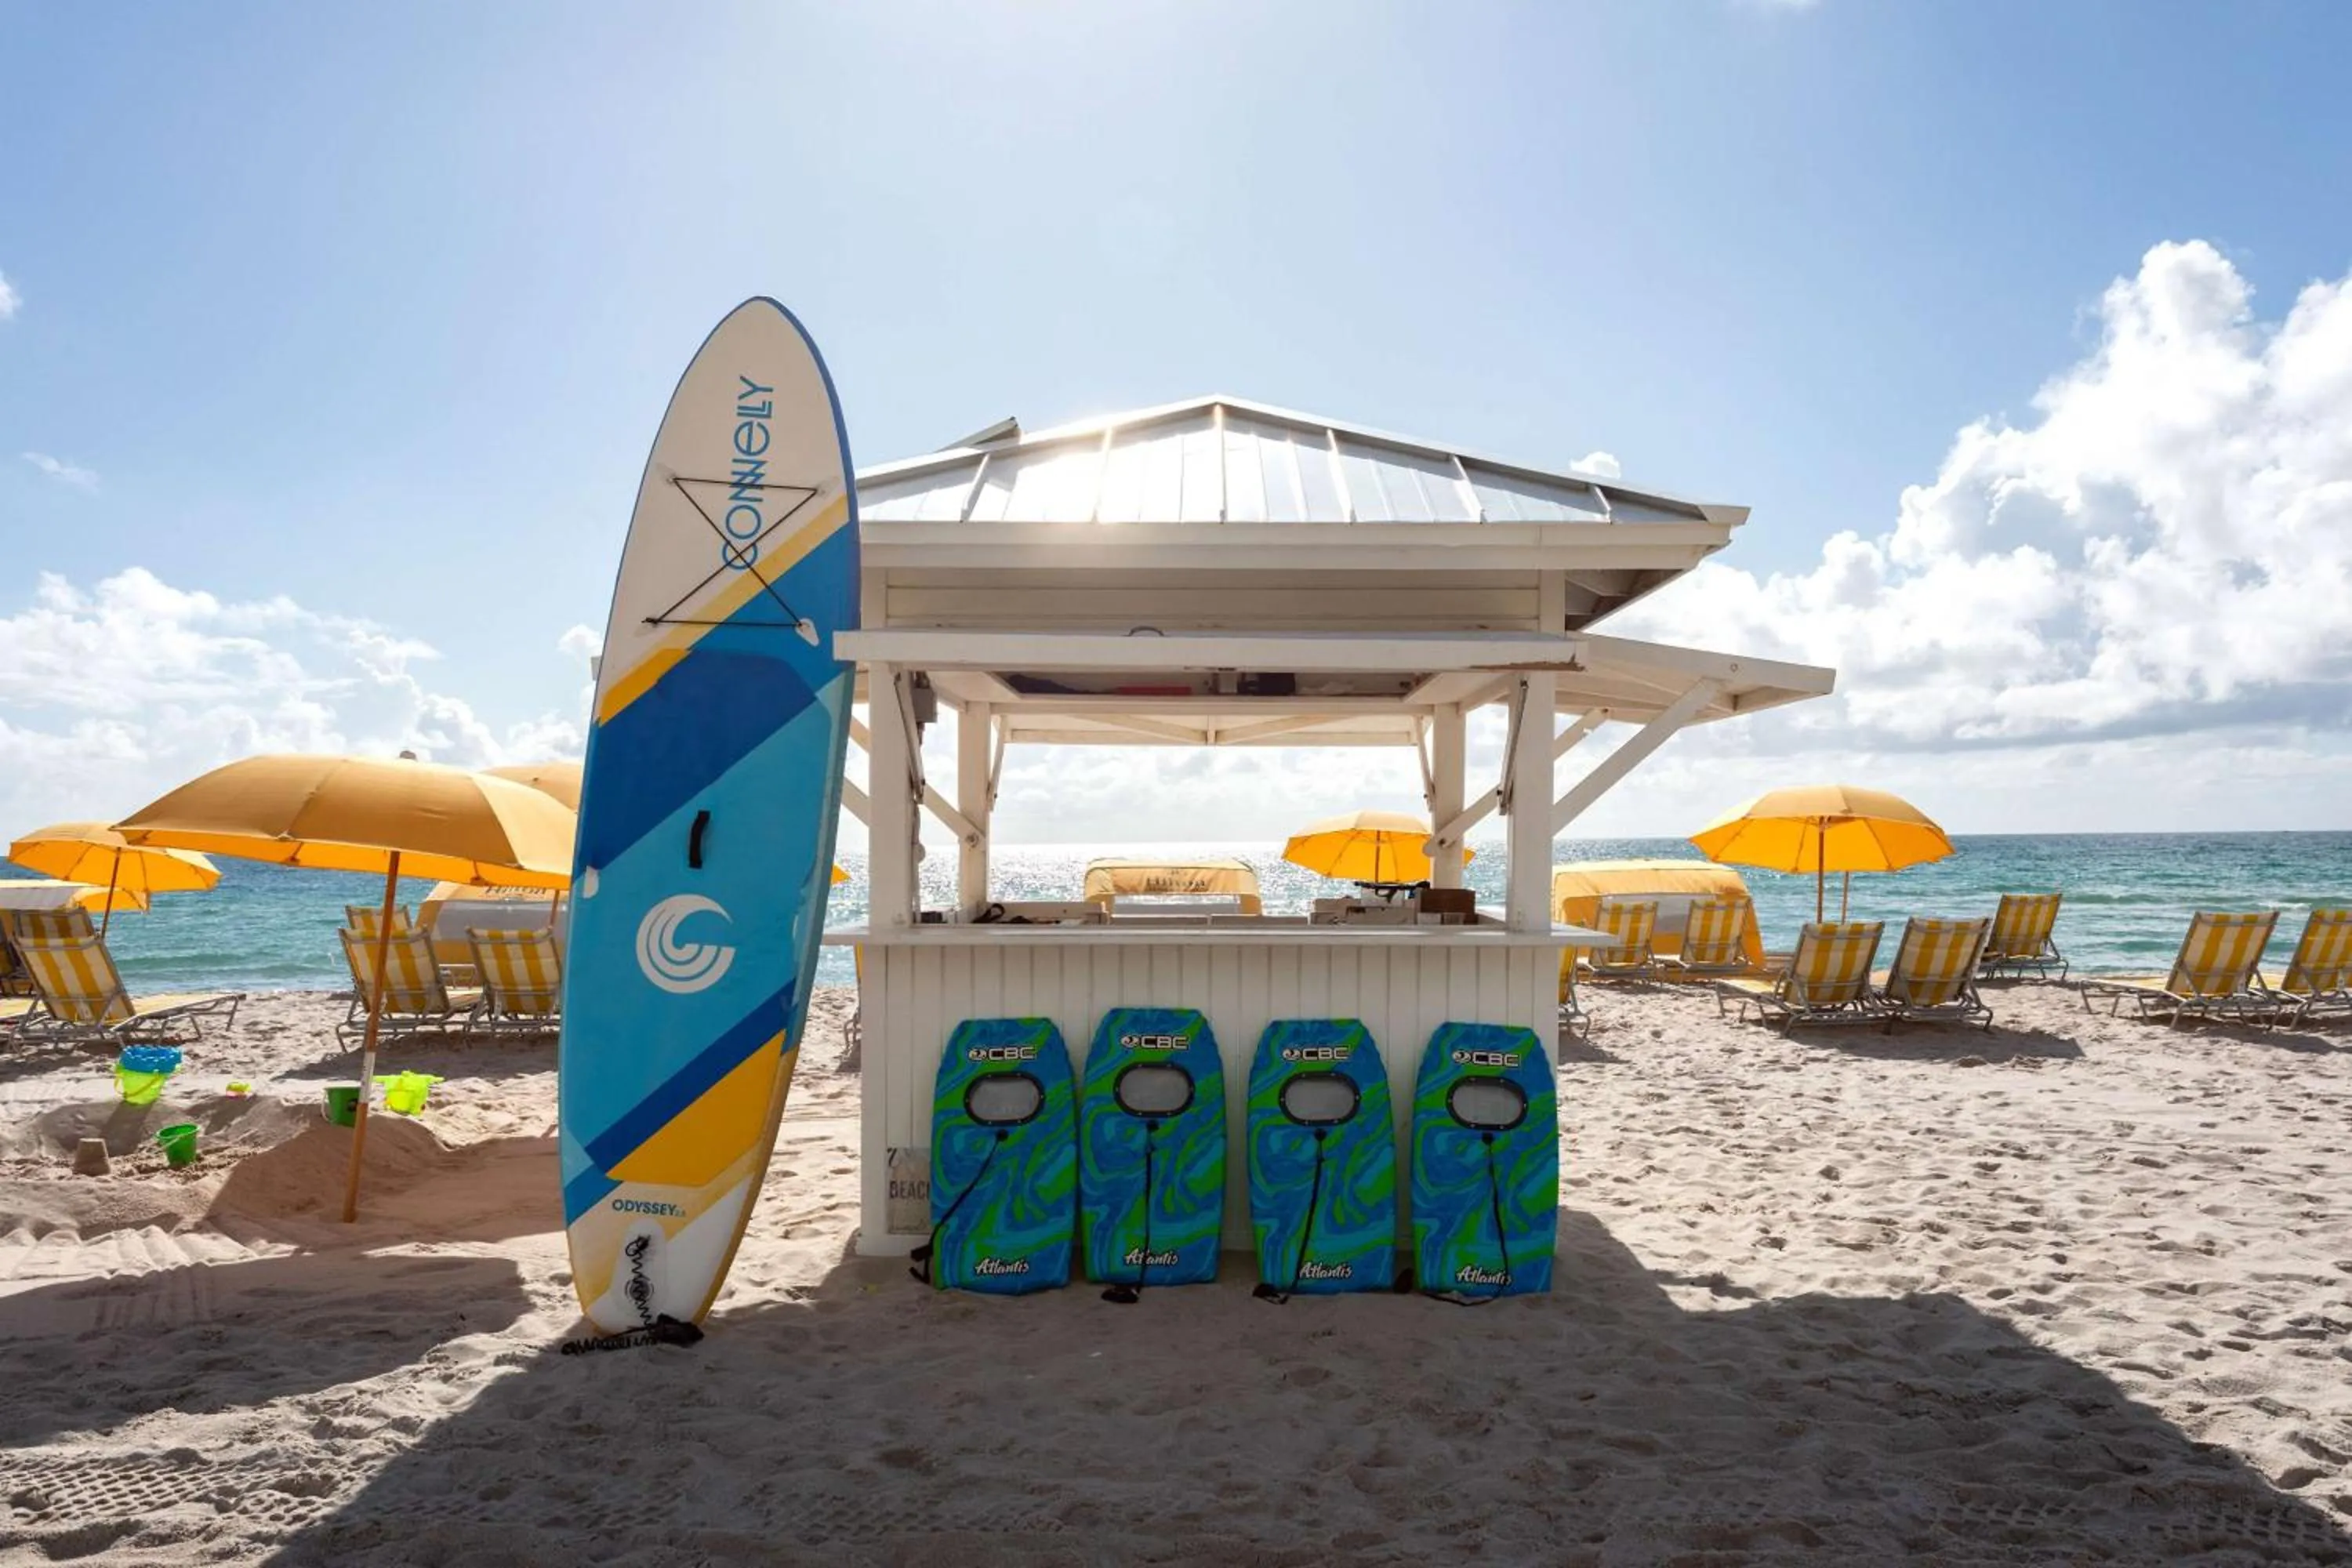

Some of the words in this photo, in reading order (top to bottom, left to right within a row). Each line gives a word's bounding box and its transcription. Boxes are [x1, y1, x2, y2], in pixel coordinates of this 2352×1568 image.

[1140, 1035, 1189, 1050] CBC
[988, 1047, 1036, 1061] CBC
[1302, 1047, 1351, 1061] CBC
[1472, 1051, 1520, 1067] CBC
[612, 1199, 677, 1216] ODYSSEY
[975, 1258, 1029, 1276] Atlantis
[1298, 1261, 1353, 1279] Atlantis
